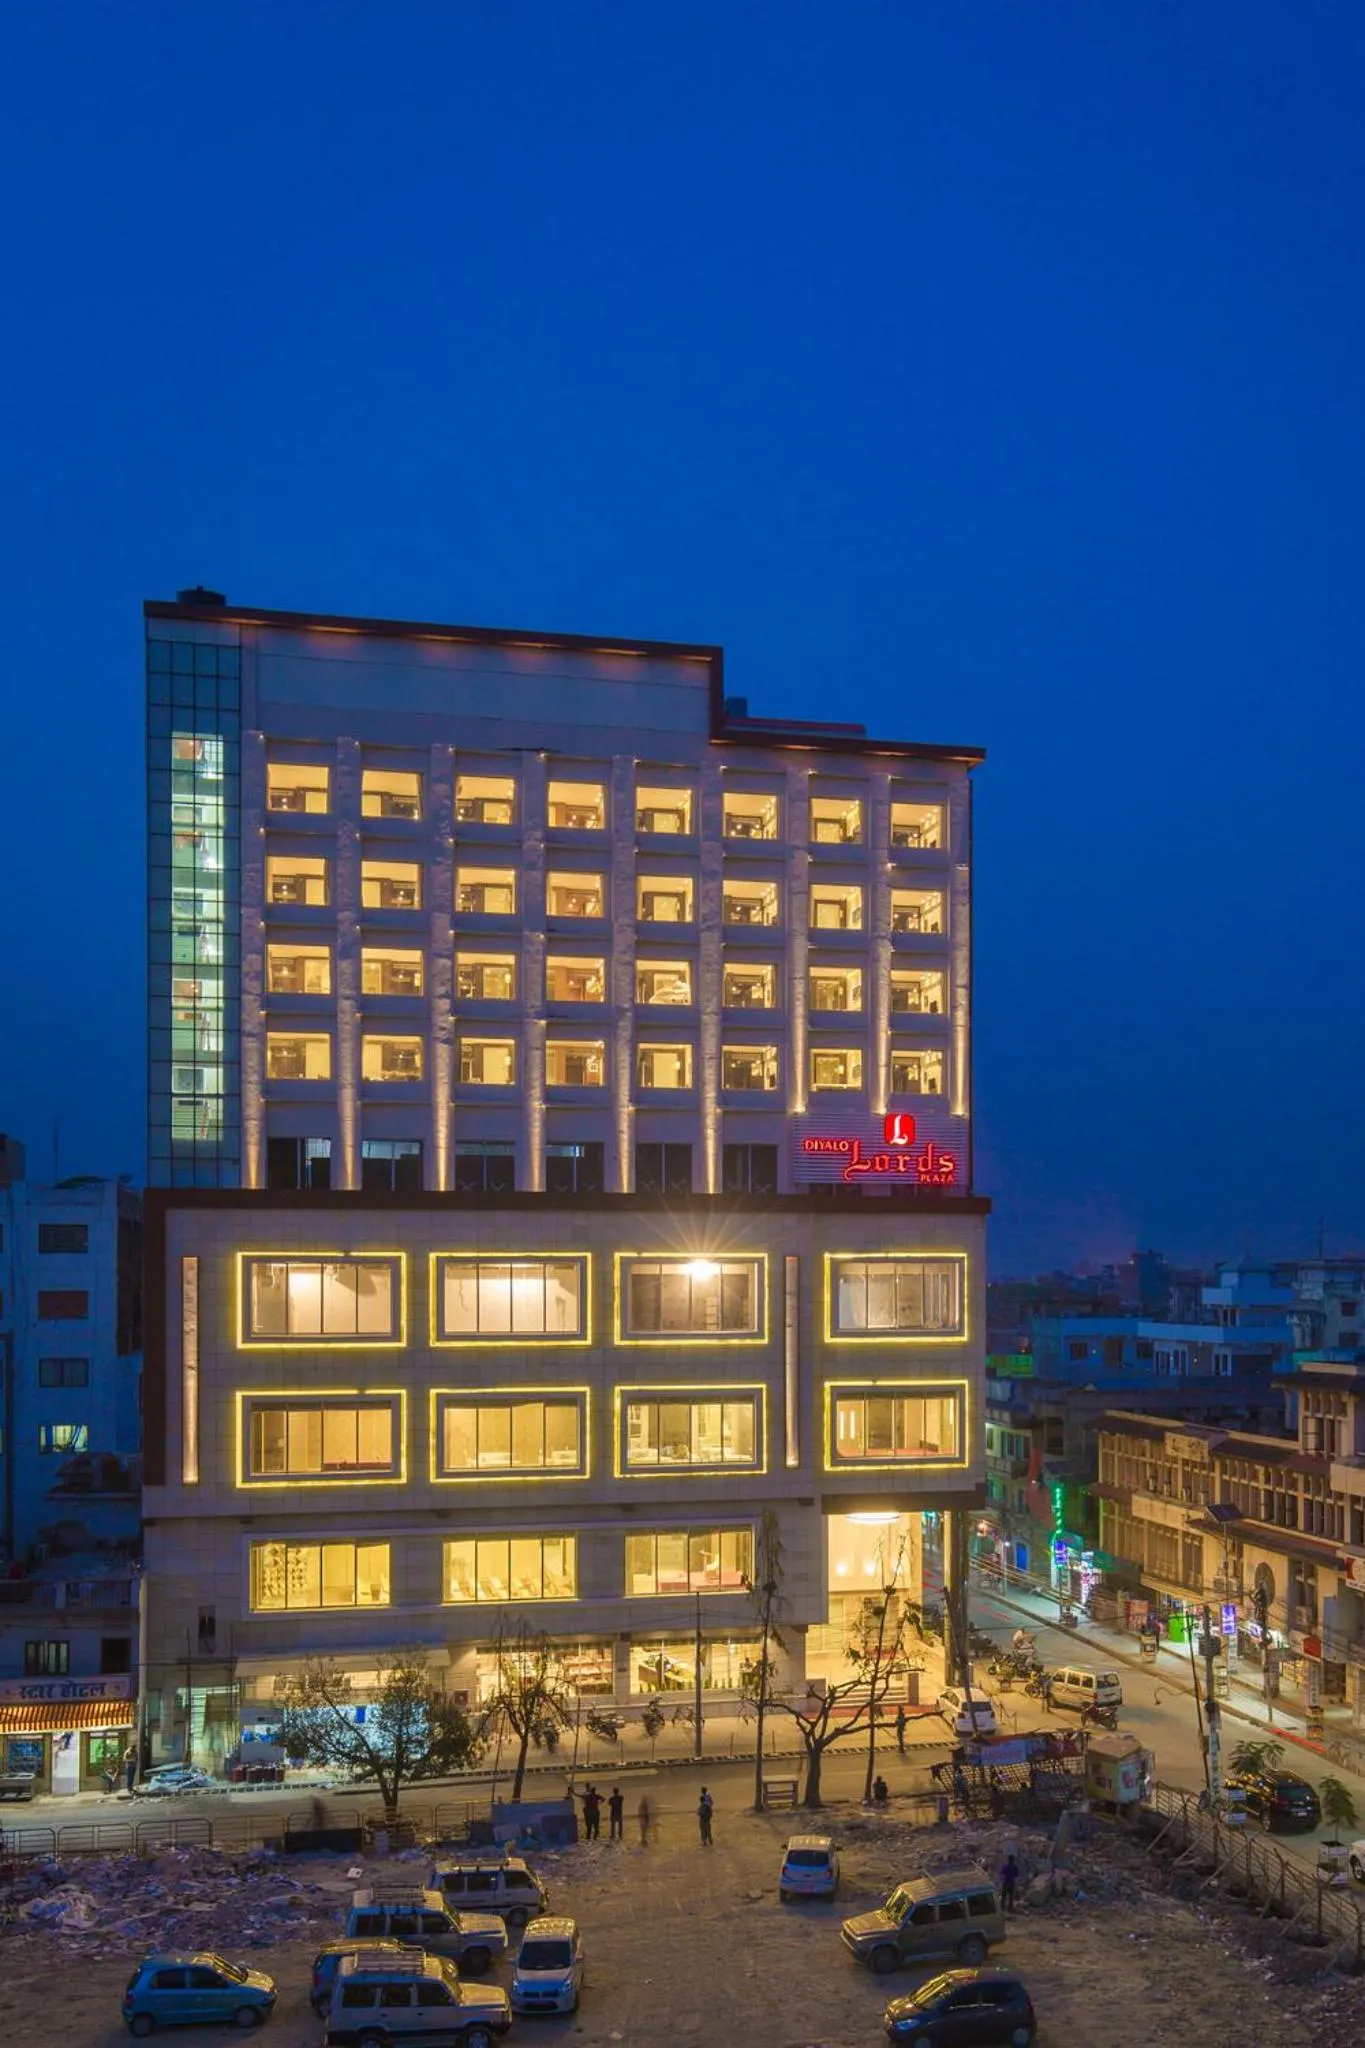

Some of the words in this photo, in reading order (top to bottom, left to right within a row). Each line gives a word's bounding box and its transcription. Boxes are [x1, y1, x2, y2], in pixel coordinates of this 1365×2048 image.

[890, 1114, 909, 1145] L
[804, 1140, 849, 1151] DIYALO
[844, 1140, 954, 1181] Lords
[920, 1174, 954, 1183] PLAZA
